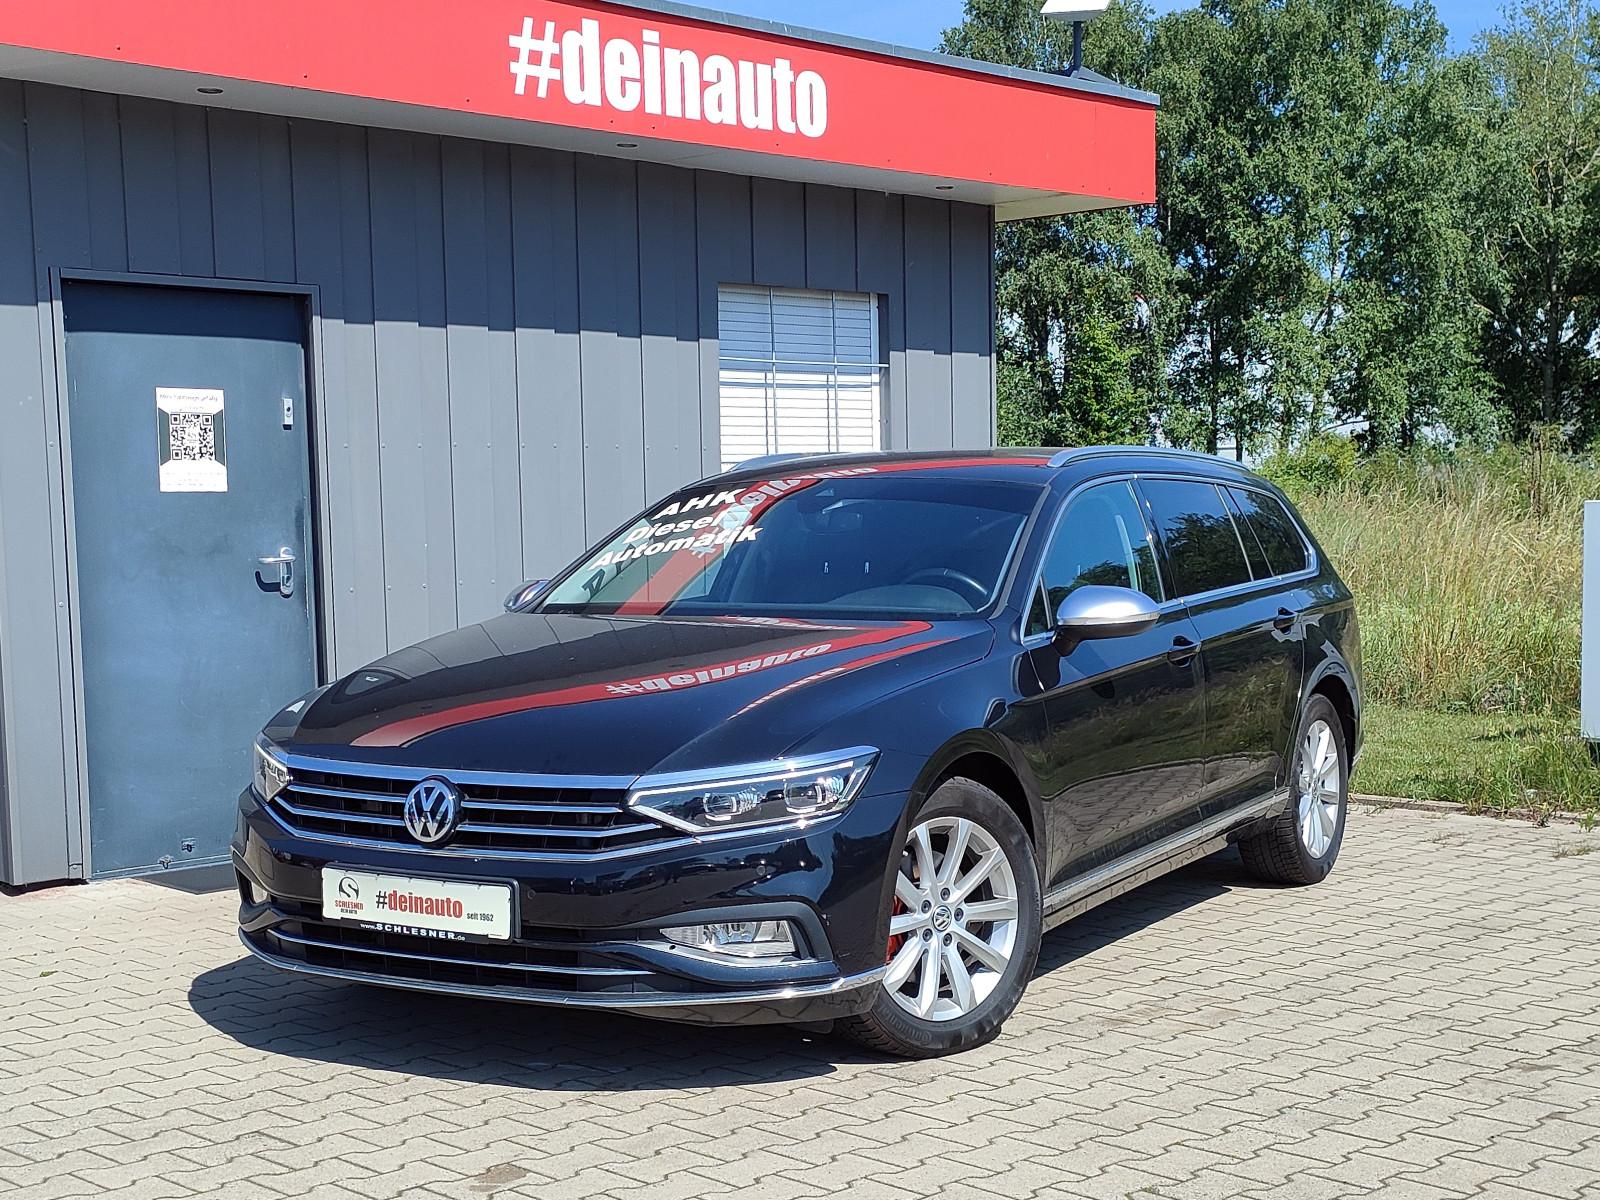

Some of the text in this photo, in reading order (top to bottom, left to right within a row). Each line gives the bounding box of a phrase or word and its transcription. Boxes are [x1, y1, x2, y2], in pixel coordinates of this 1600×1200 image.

[508, 16, 828, 138] #deinauto
[651, 488, 746, 520] AHK
[622, 509, 732, 544] Diesel
[588, 525, 764, 571] Automatik
[375, 890, 463, 919] #deinauto
[466, 912, 494, 922] seit 1962
[360, 923, 466, 941] www.SCHLESNER.de
